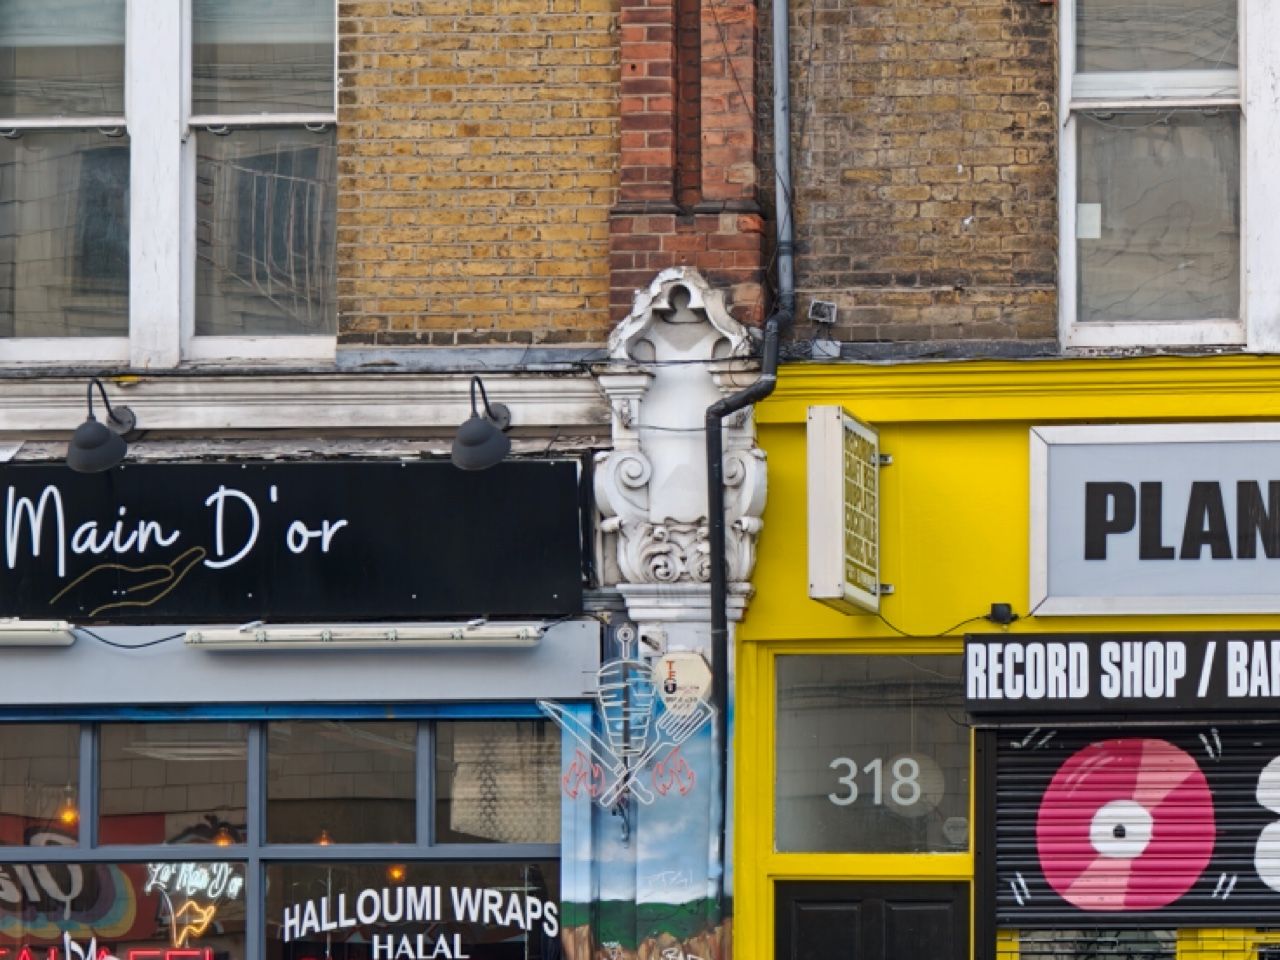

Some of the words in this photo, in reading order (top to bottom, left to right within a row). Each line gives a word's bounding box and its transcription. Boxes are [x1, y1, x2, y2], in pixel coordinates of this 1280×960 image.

[6, 484, 181, 578] Main
[203, 484, 349, 569] D'or
[966, 642, 1090, 700] RECORD
[1099, 641, 1187, 699] SHOP
[1197, 641, 1217, 698] /
[828, 757, 921, 806] 318
[284, 886, 442, 943] HALLOUMI
[450, 886, 559, 938] WRAPS
[372, 933, 470, 960] HALAL
